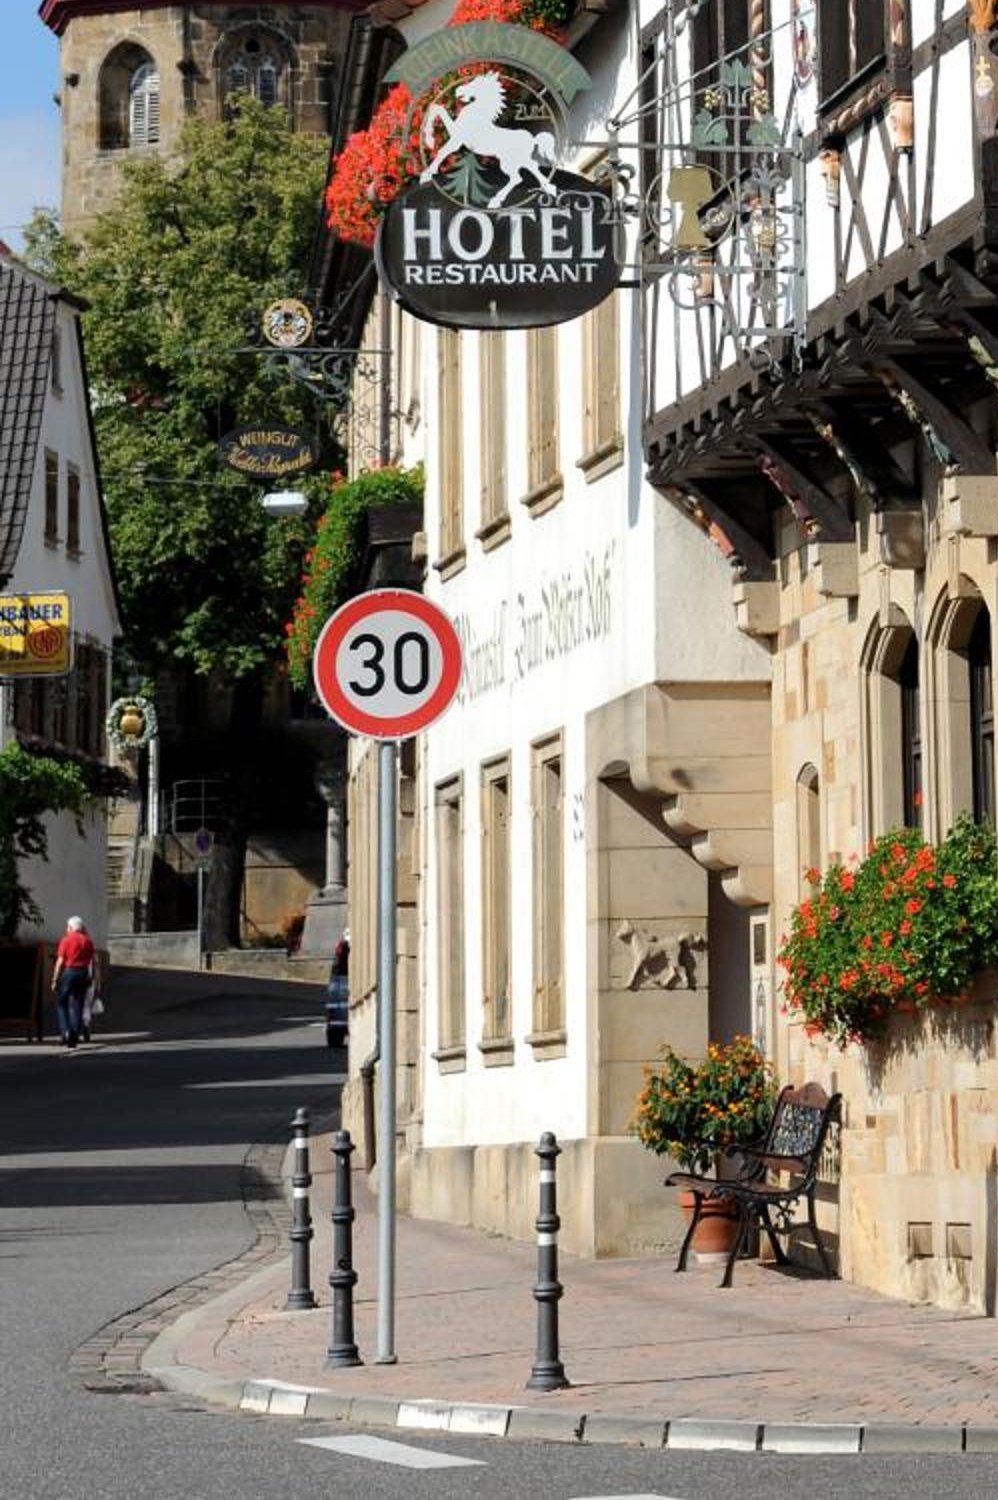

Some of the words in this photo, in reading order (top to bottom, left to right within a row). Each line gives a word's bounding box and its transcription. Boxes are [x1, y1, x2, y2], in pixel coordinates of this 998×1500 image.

[514, 103, 546, 118] ZUM
[402, 208, 606, 261] HOTEL
[404, 263, 599, 285] RESTAURANT
[239, 430, 300, 448] WEINGUT
[350, 632, 429, 697] 30
